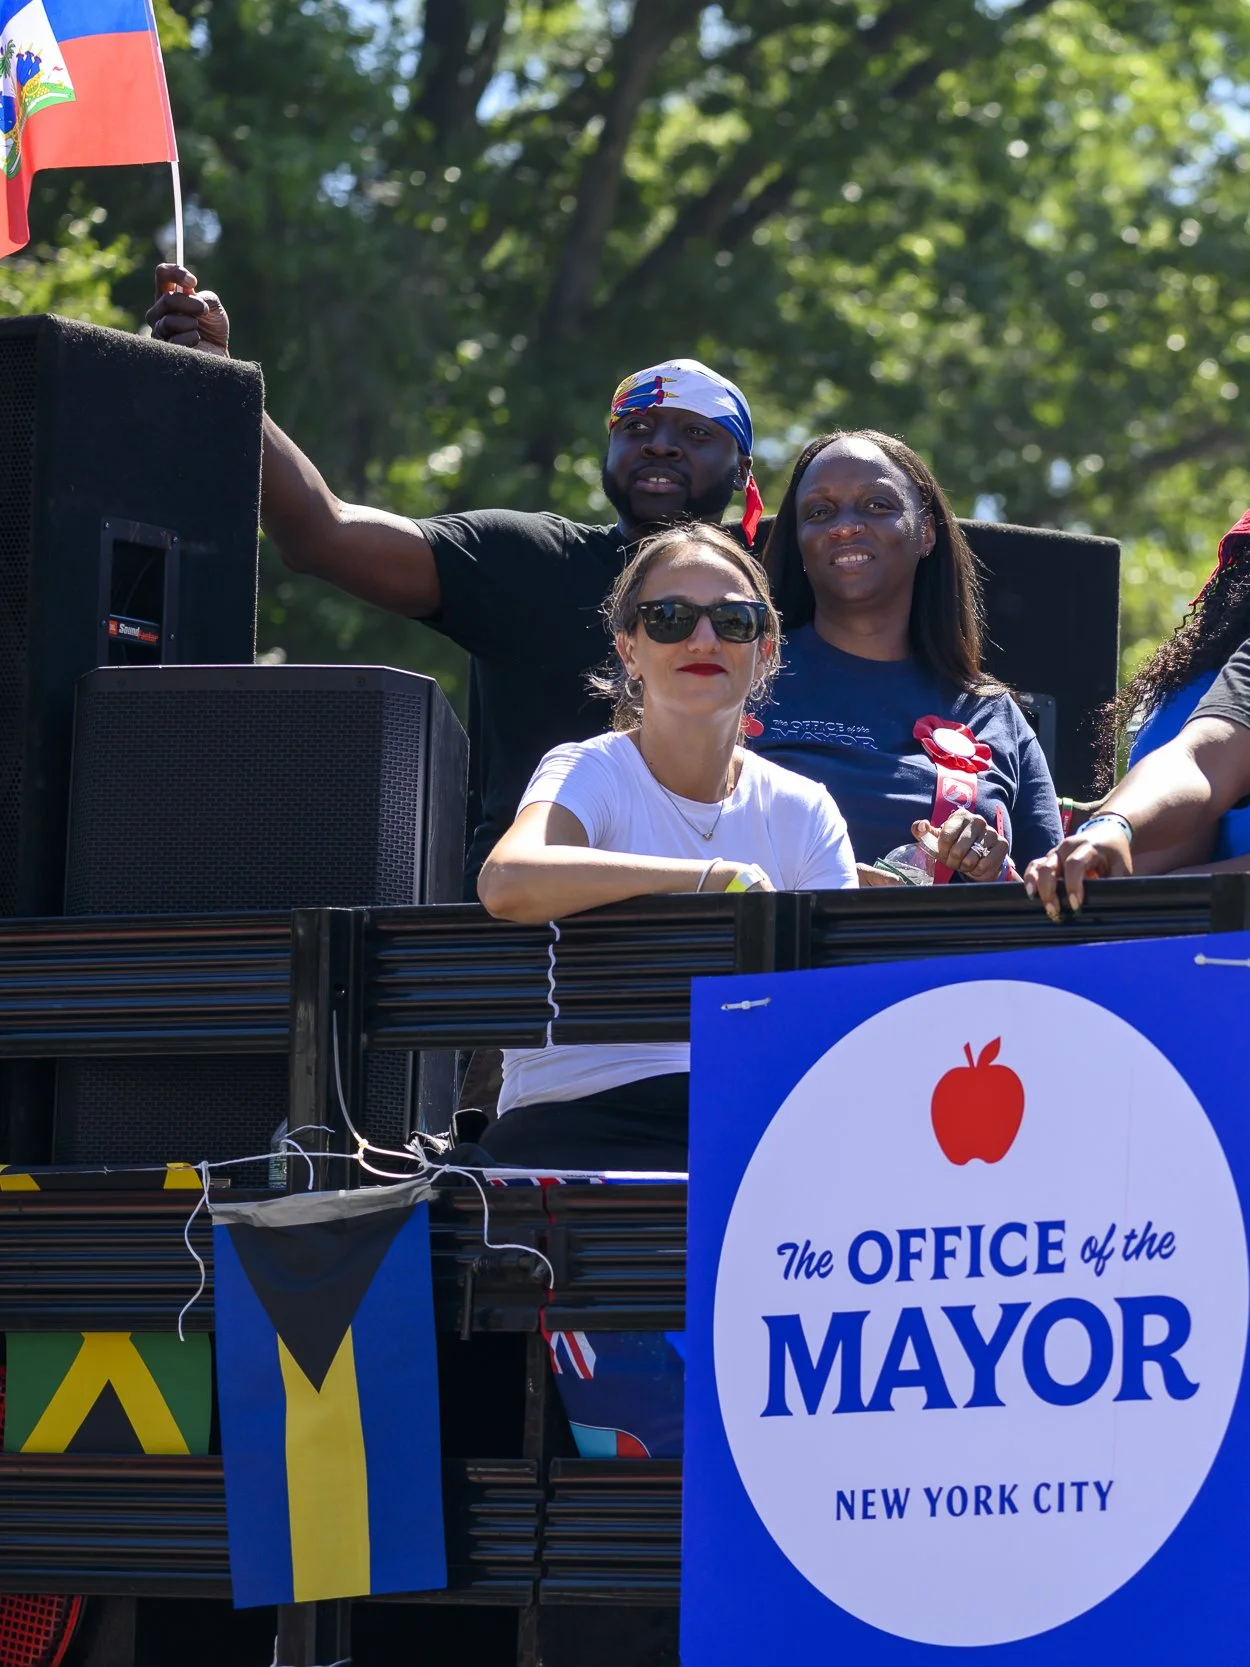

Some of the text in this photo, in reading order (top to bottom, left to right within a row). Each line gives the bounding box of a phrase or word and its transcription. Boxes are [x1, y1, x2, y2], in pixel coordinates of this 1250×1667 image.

[791, 720, 844, 732] OFFICE
[776, 1219, 1176, 1286] The OFFICE of the
[759, 1294, 1201, 1418] MAYOR
[835, 1480, 1114, 1521] NEW YORK CITY
